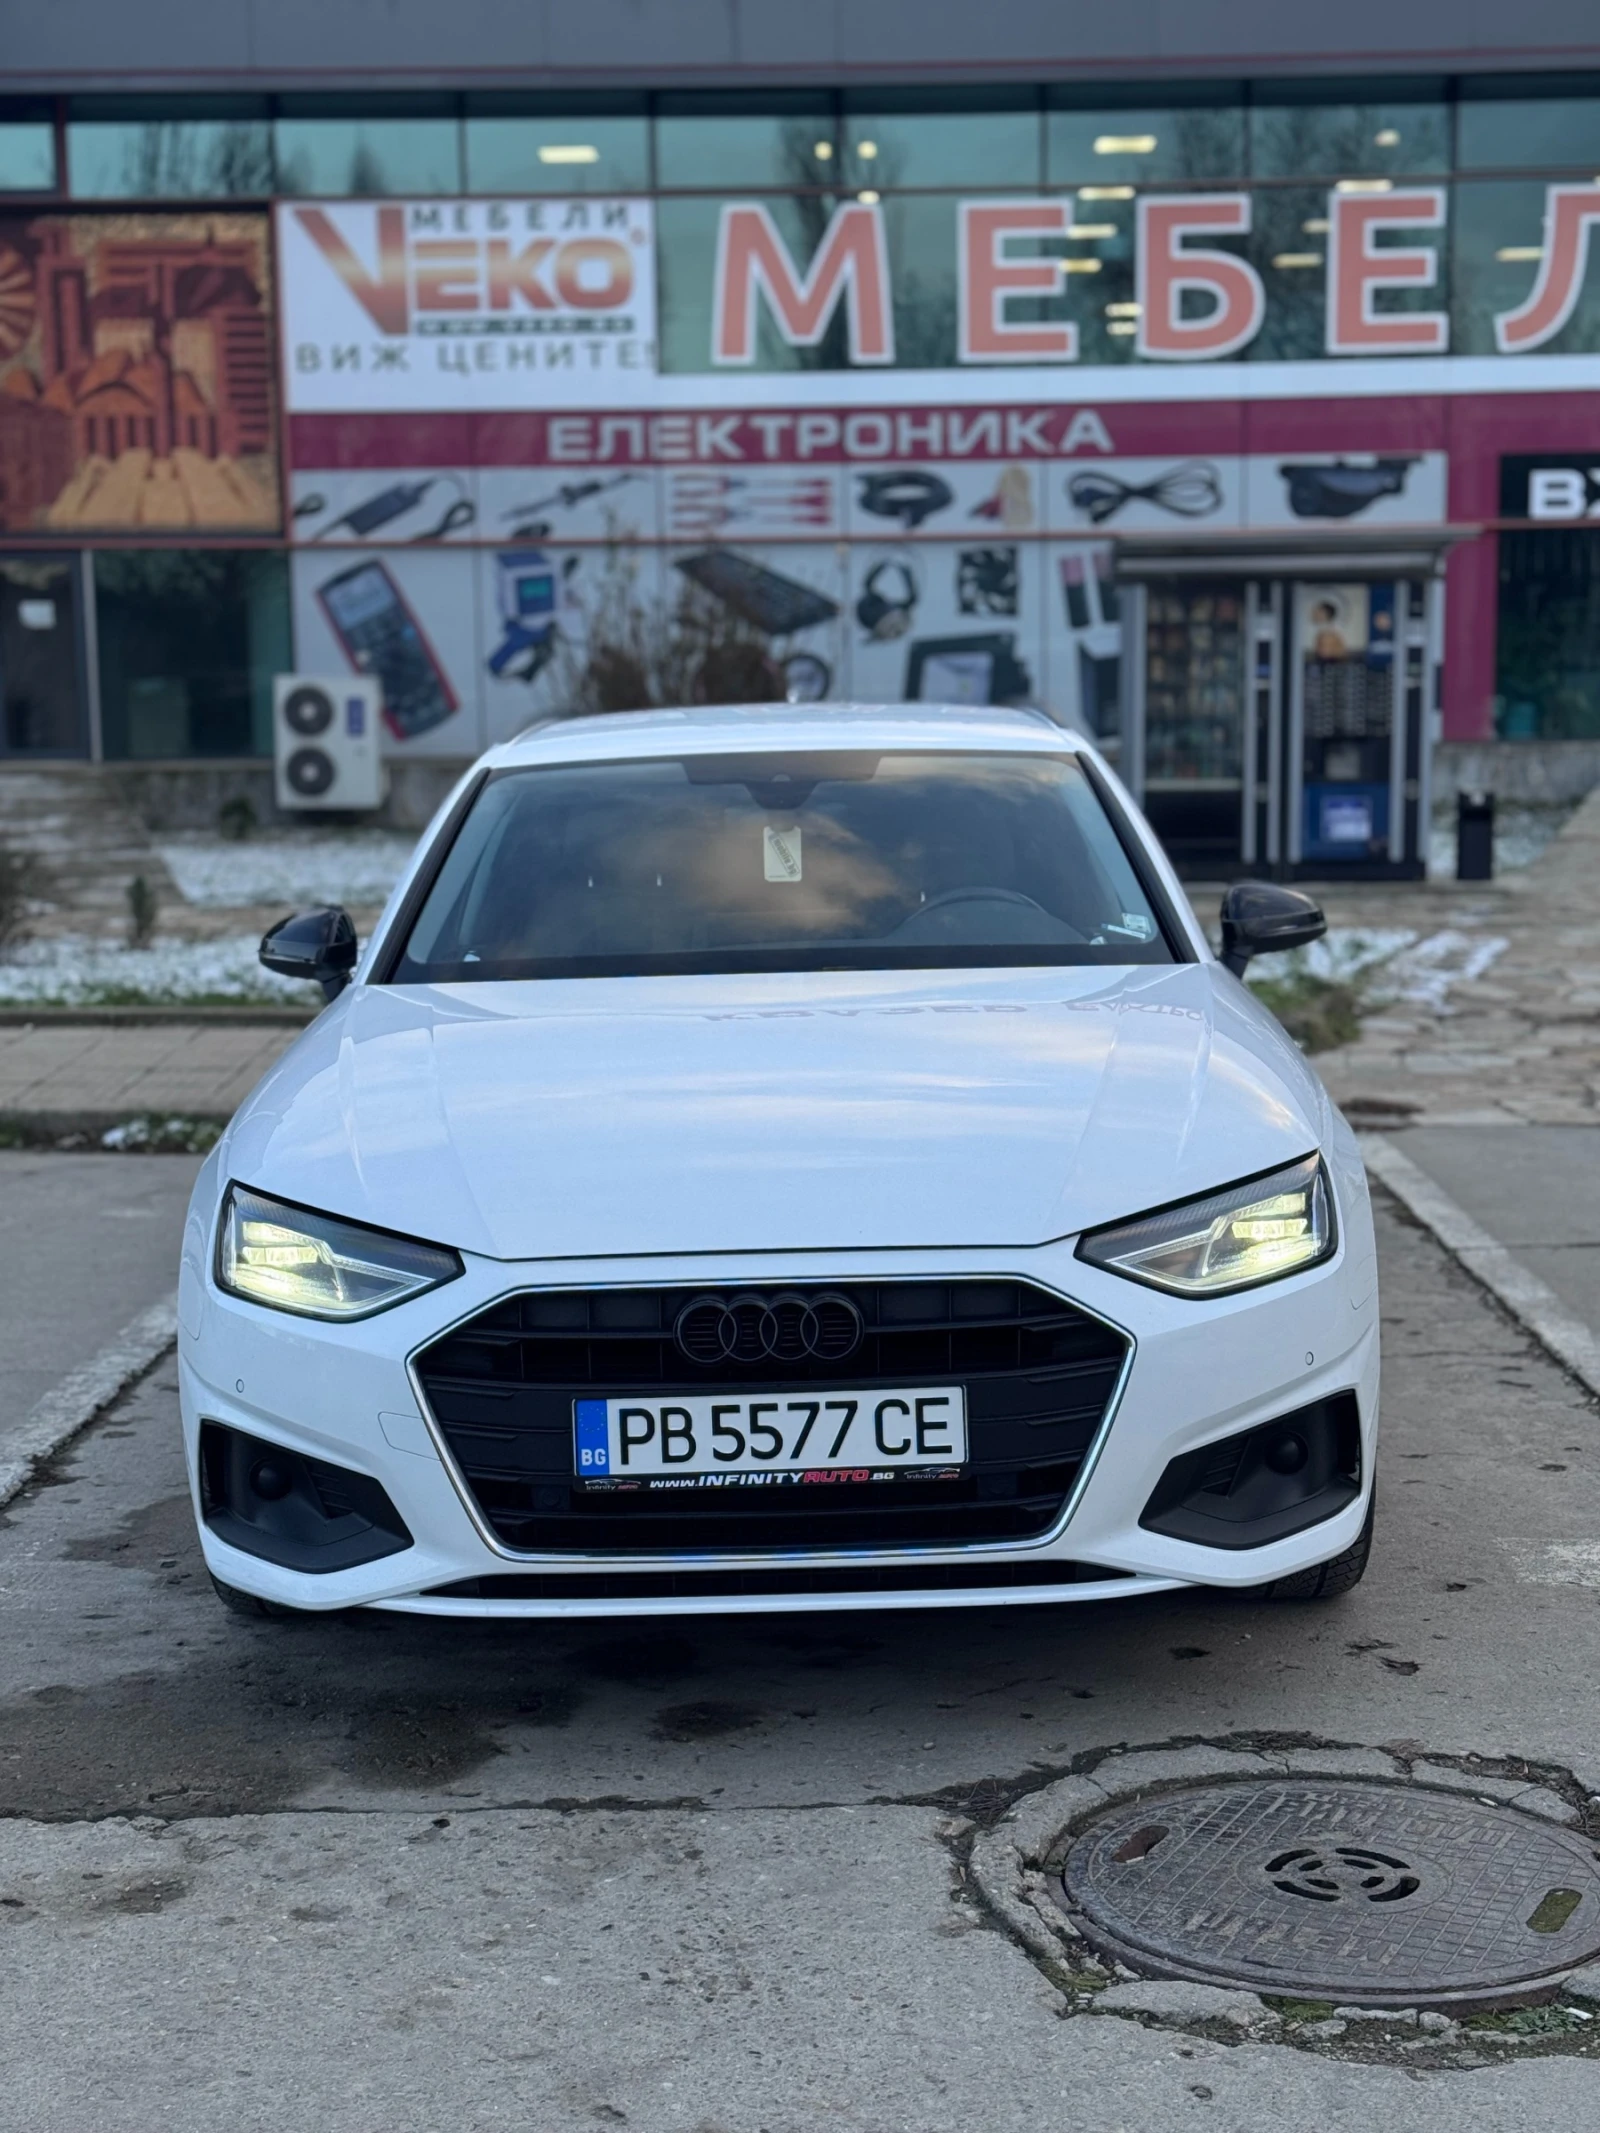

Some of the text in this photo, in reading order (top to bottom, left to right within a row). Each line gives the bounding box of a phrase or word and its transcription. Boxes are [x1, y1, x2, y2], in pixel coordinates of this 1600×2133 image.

[411, 204, 629, 232] МЕБЕЛИ
[294, 207, 633, 336] VEKO
[295, 341, 410, 374] ВИЖ
[547, 411, 1114, 462] ЕЛЕКТРОНИКА
[618, 1396, 953, 1466] PB 5577 CE
[580, 1448, 607, 1466] BG
